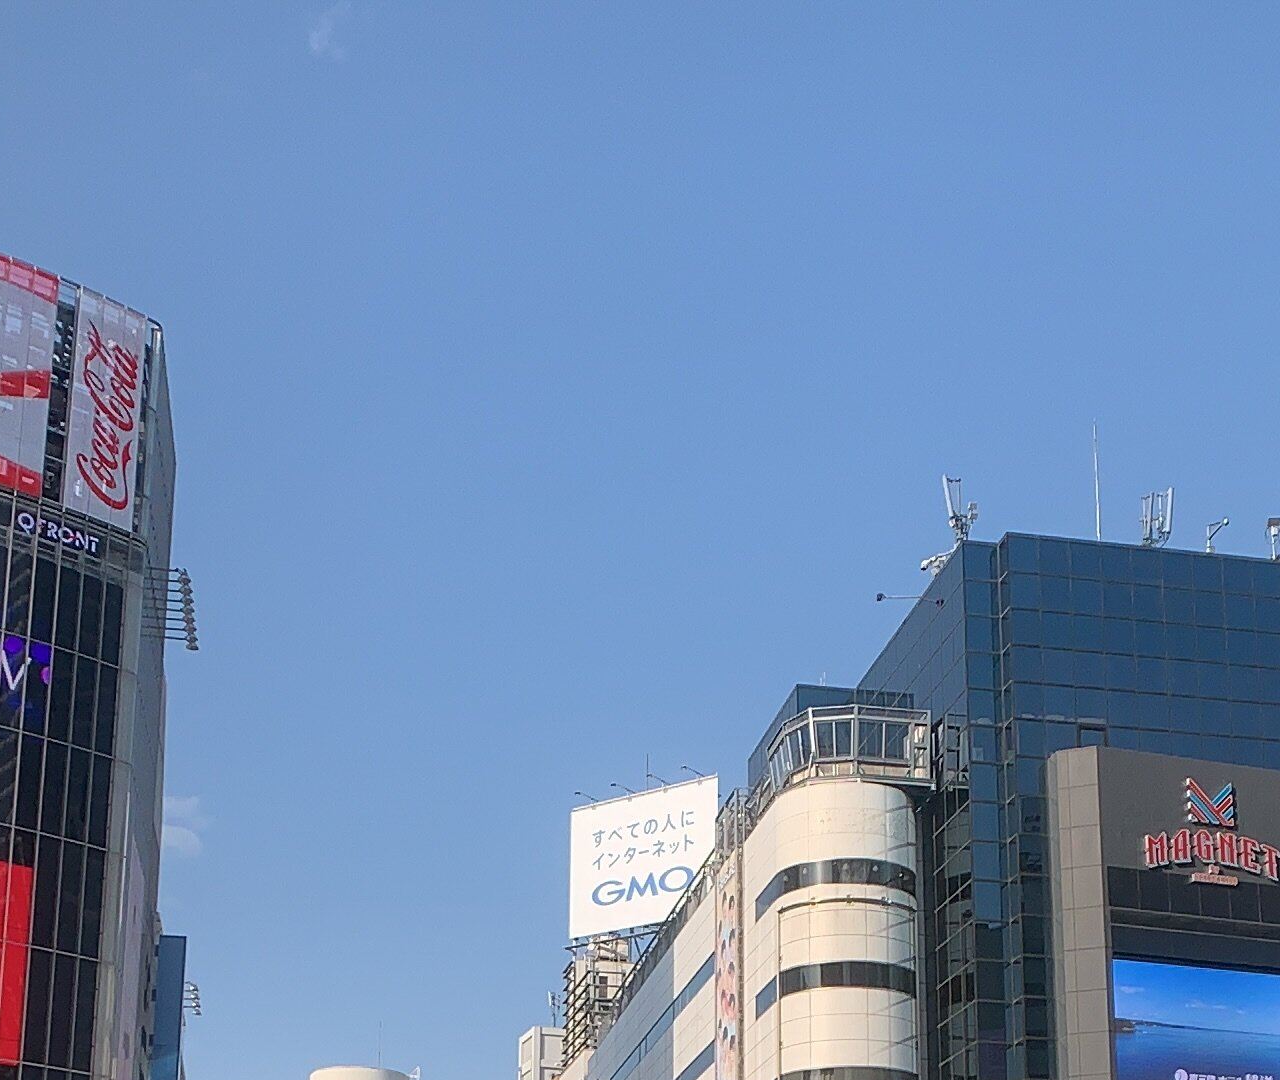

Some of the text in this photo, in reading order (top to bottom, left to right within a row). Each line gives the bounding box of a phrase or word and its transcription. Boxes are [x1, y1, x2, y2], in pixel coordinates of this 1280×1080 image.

[76, 318, 140, 511] Coca-Cola
[592, 809, 696, 849] すべての人に
[591, 833, 696, 872] インターネット
[591, 865, 695, 907] GMO
